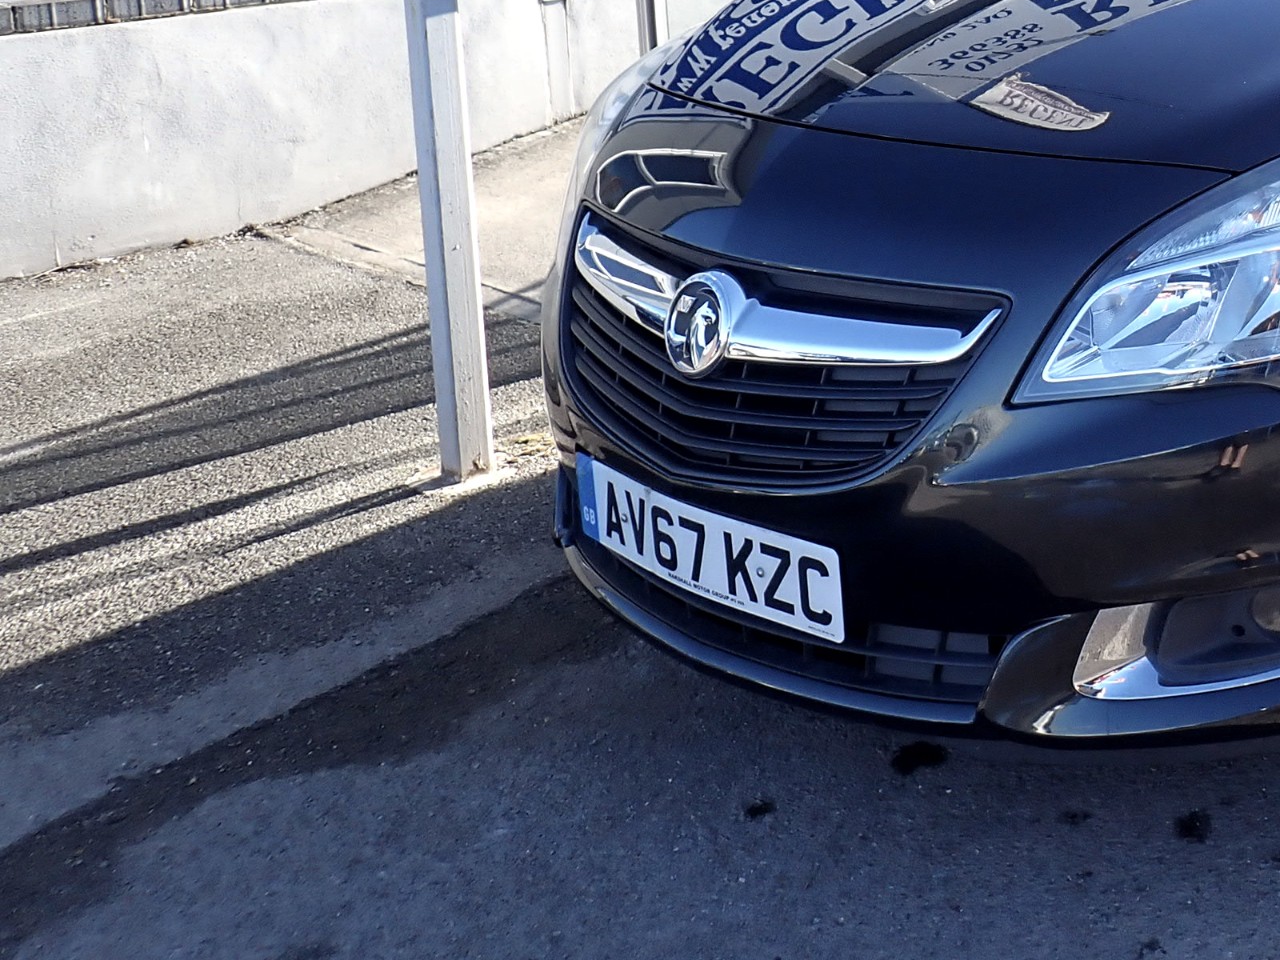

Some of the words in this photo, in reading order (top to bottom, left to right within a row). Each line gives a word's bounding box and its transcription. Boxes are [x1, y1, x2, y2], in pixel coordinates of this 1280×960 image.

[582, 507, 596, 525] GB
[606, 481, 706, 583] AV67
[723, 530, 833, 626] KZC
